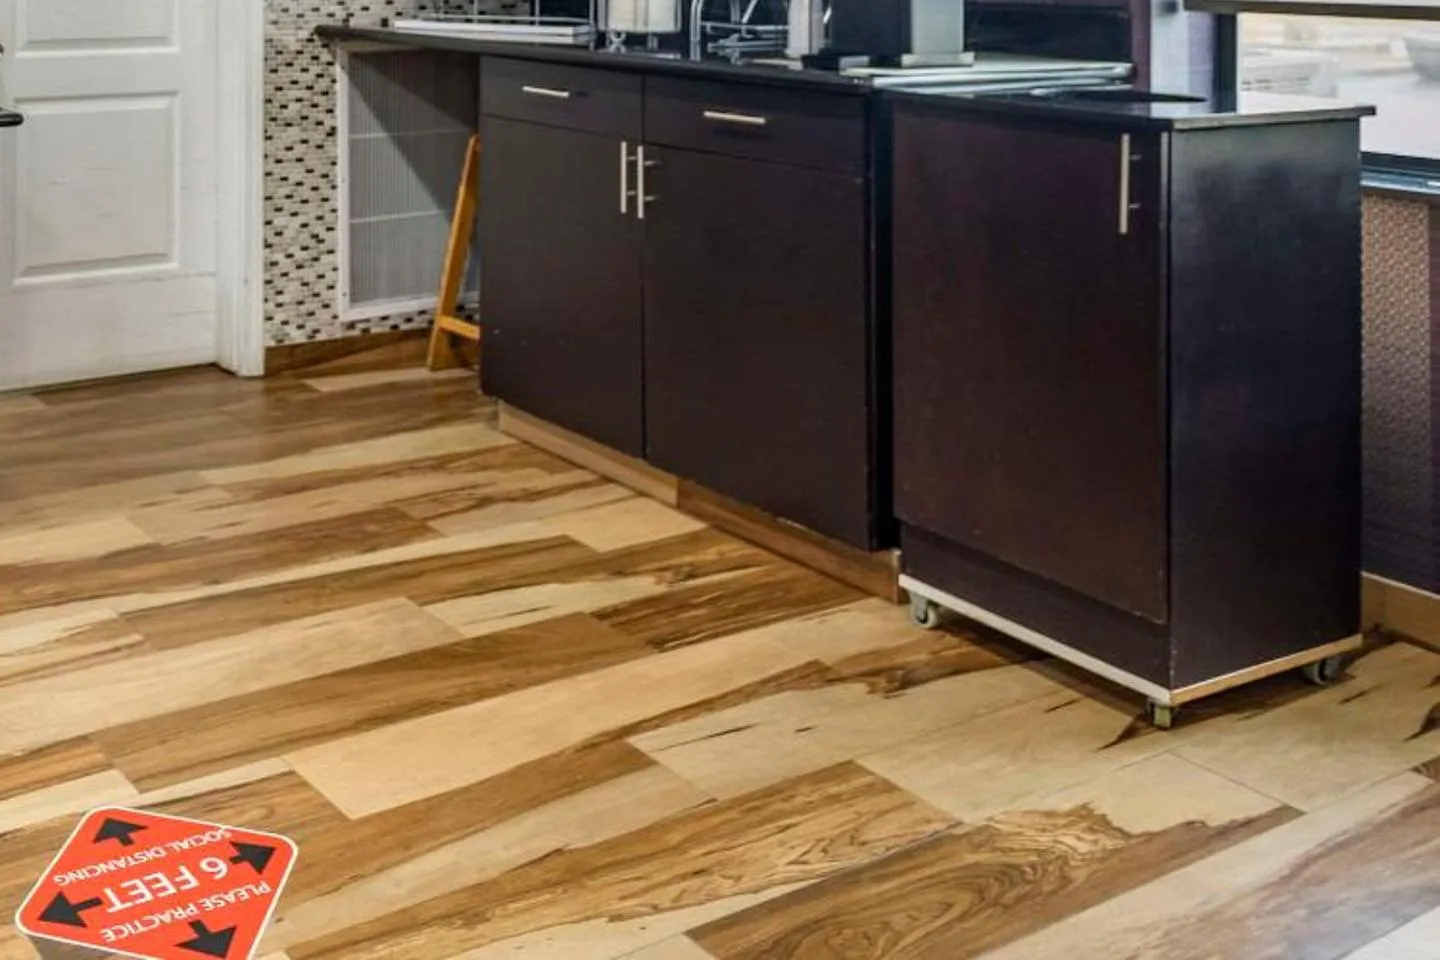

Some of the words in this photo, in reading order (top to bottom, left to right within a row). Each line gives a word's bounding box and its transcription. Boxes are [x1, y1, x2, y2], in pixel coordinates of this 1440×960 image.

[167, 828, 232, 853] SOCIAL
[53, 847, 167, 886] DISTANCING
[200, 857, 228, 880] 6
[103, 865, 200, 913] FEET
[198, 881, 271, 912] PLEASE
[103, 904, 200, 942] PRACTICE
